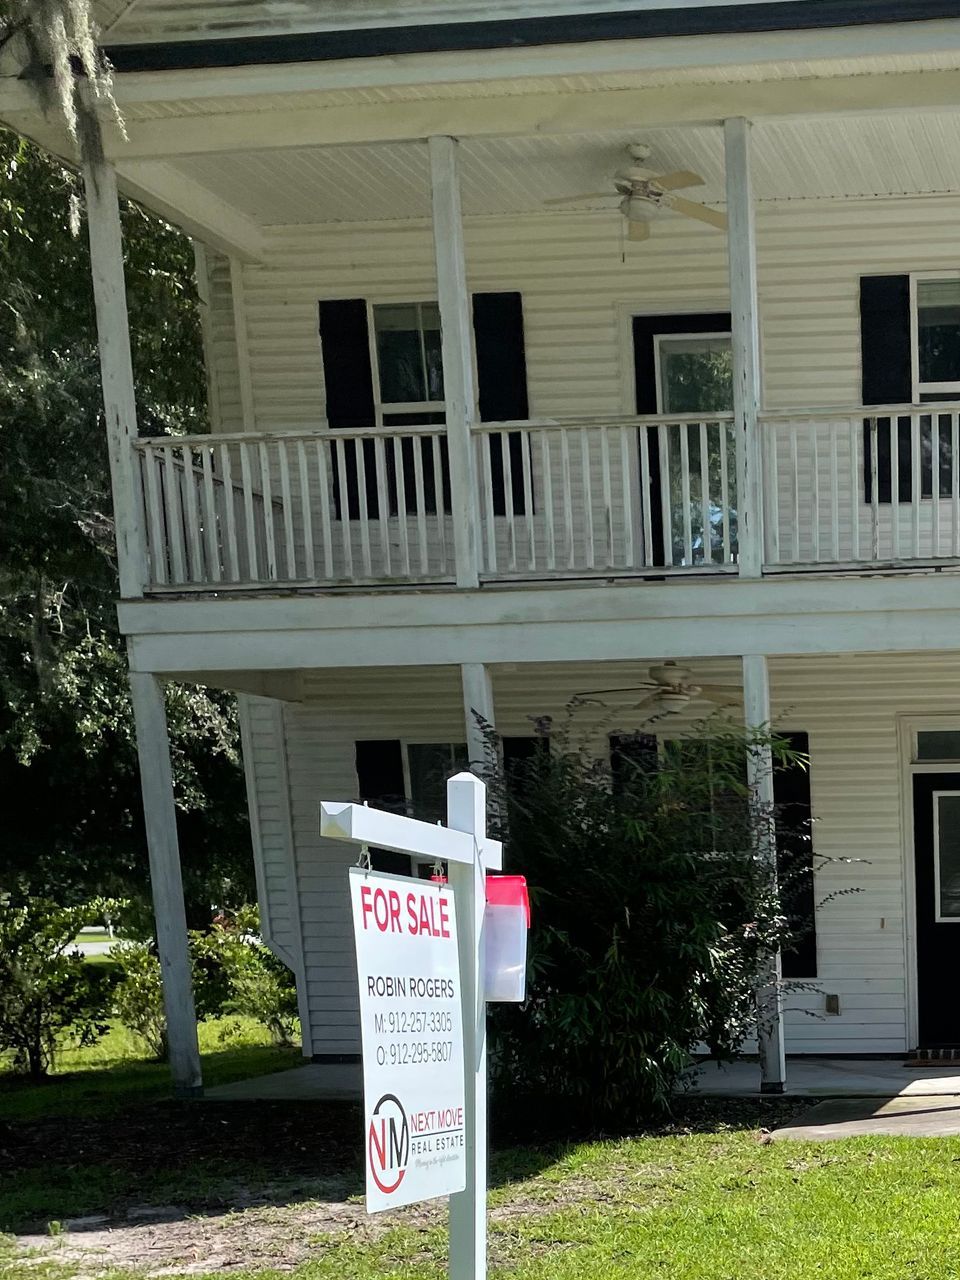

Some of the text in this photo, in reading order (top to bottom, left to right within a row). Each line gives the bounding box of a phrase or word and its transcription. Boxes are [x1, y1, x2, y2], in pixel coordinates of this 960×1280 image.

[360, 885, 450, 938] FOR SALE
[367, 975, 455, 999] ROBIN ROGERS
[374, 1011, 453, 1034] M: 912-257-3305
[376, 1041, 453, 1067] O: 912-295-5807
[410, 1107, 463, 1133] NEXT MOVE
[411, 1134, 464, 1156] REAL ESTATE
